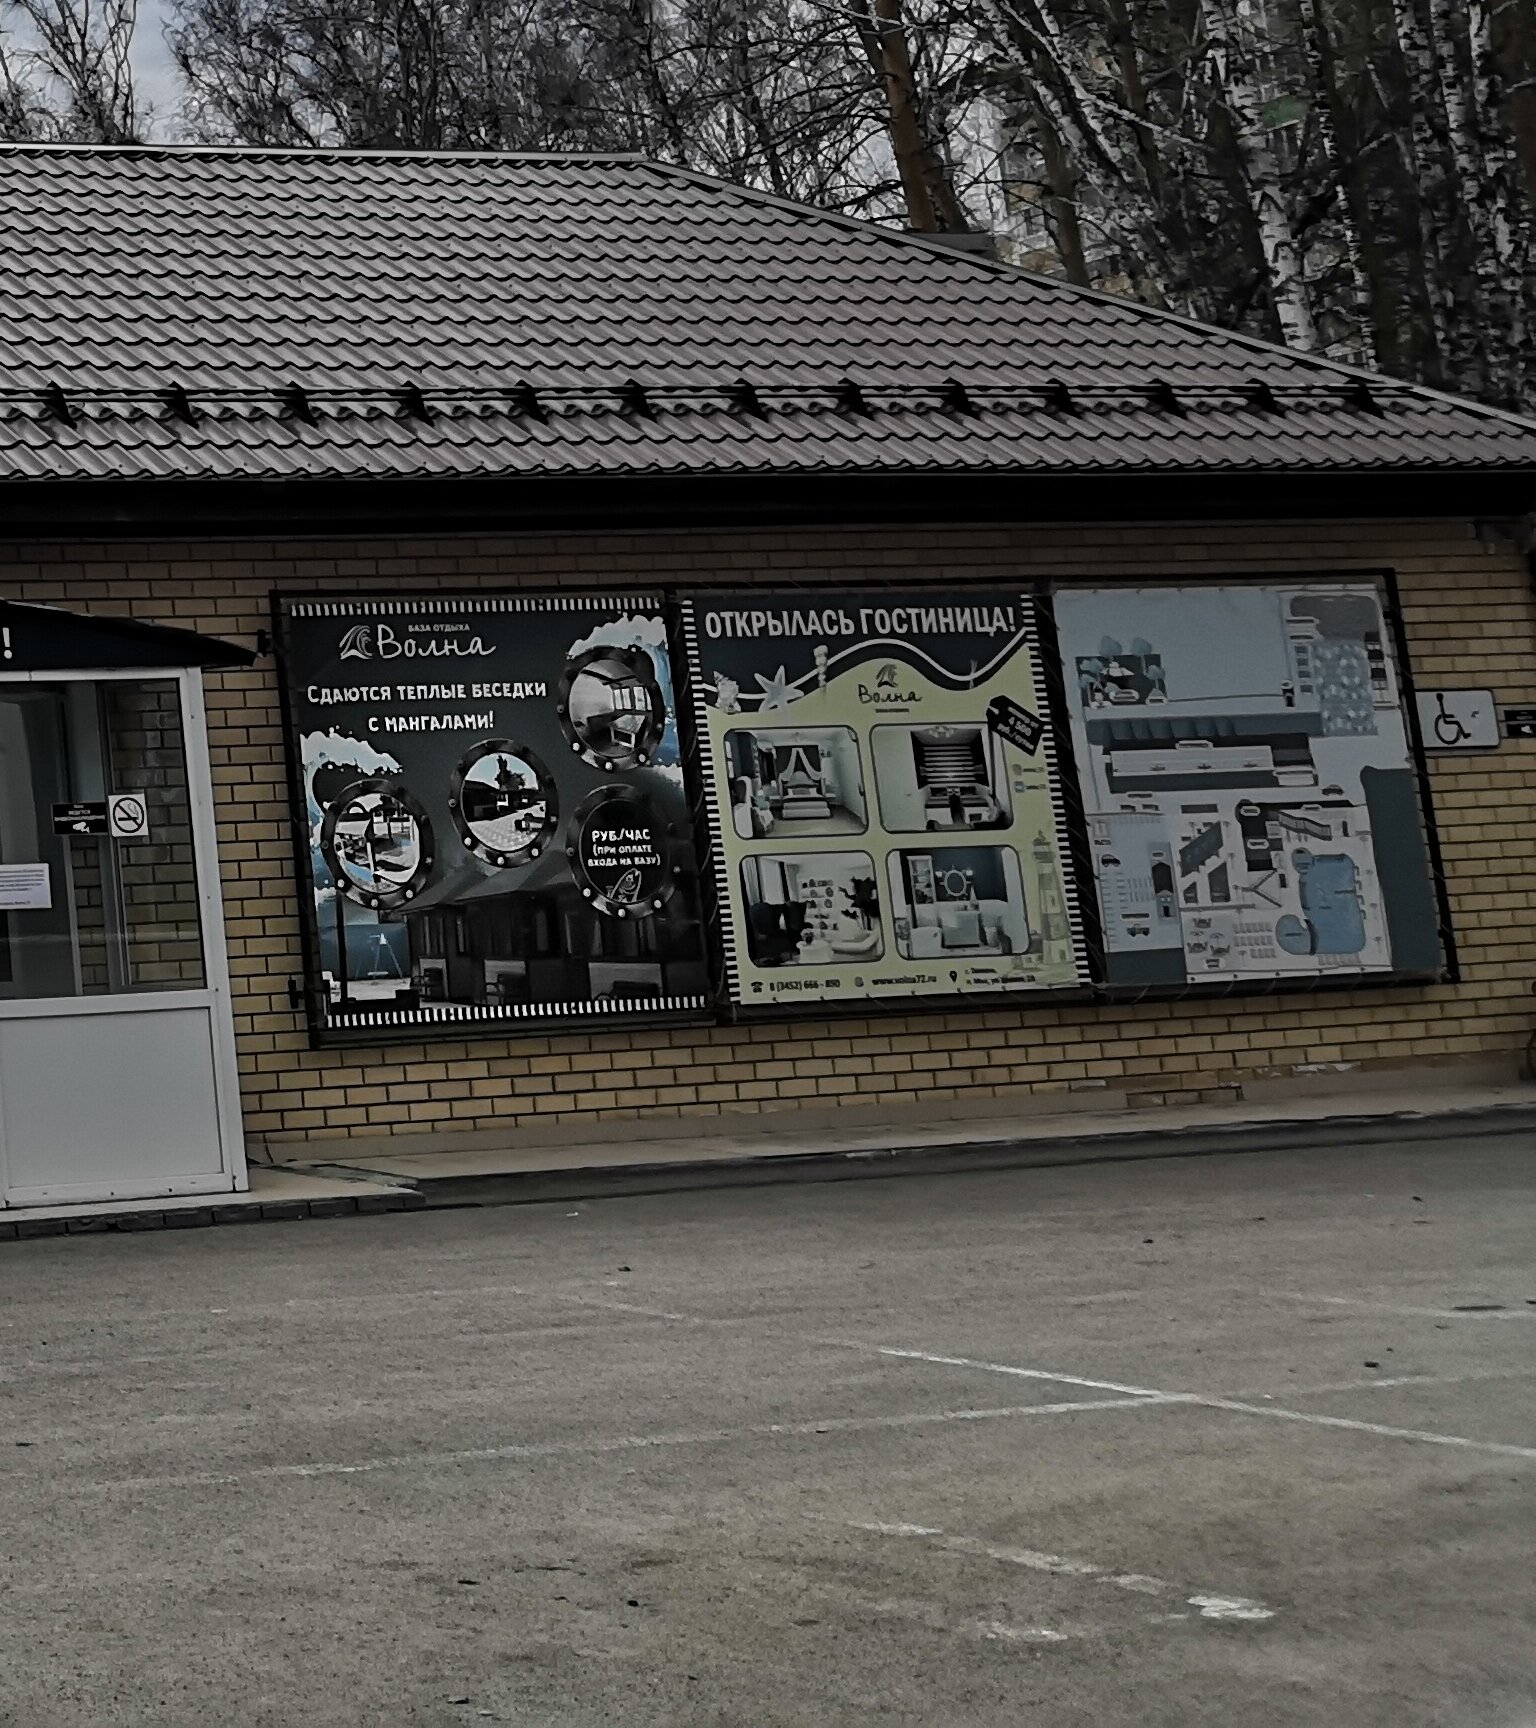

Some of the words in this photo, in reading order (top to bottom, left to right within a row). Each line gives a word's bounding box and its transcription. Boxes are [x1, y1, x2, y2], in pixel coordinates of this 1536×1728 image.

[408, 623, 431, 632] БАЗА
[433, 623, 470, 632] ОТДЫХА
[705, 608, 855, 638] ОТКРЫЛАСЬ
[859, 607, 1016, 637] ГОСТИНИЦА!
[377, 624, 497, 659] Волна
[397, 683, 467, 701] ТЕПЛЫЕ
[472, 682, 547, 699] БЕСЕДКИ
[857, 683, 923, 704] Волна
[385, 710, 494, 732] МАНГАЛАМИ!
[591, 828, 651, 842] РУБ./ЧАС
[592, 844, 616, 857] (ПРИ
[618, 844, 652, 854] ОПЛАТЕ
[588, 858, 618, 867] ВХОДА
[619, 857, 632, 866] НА
